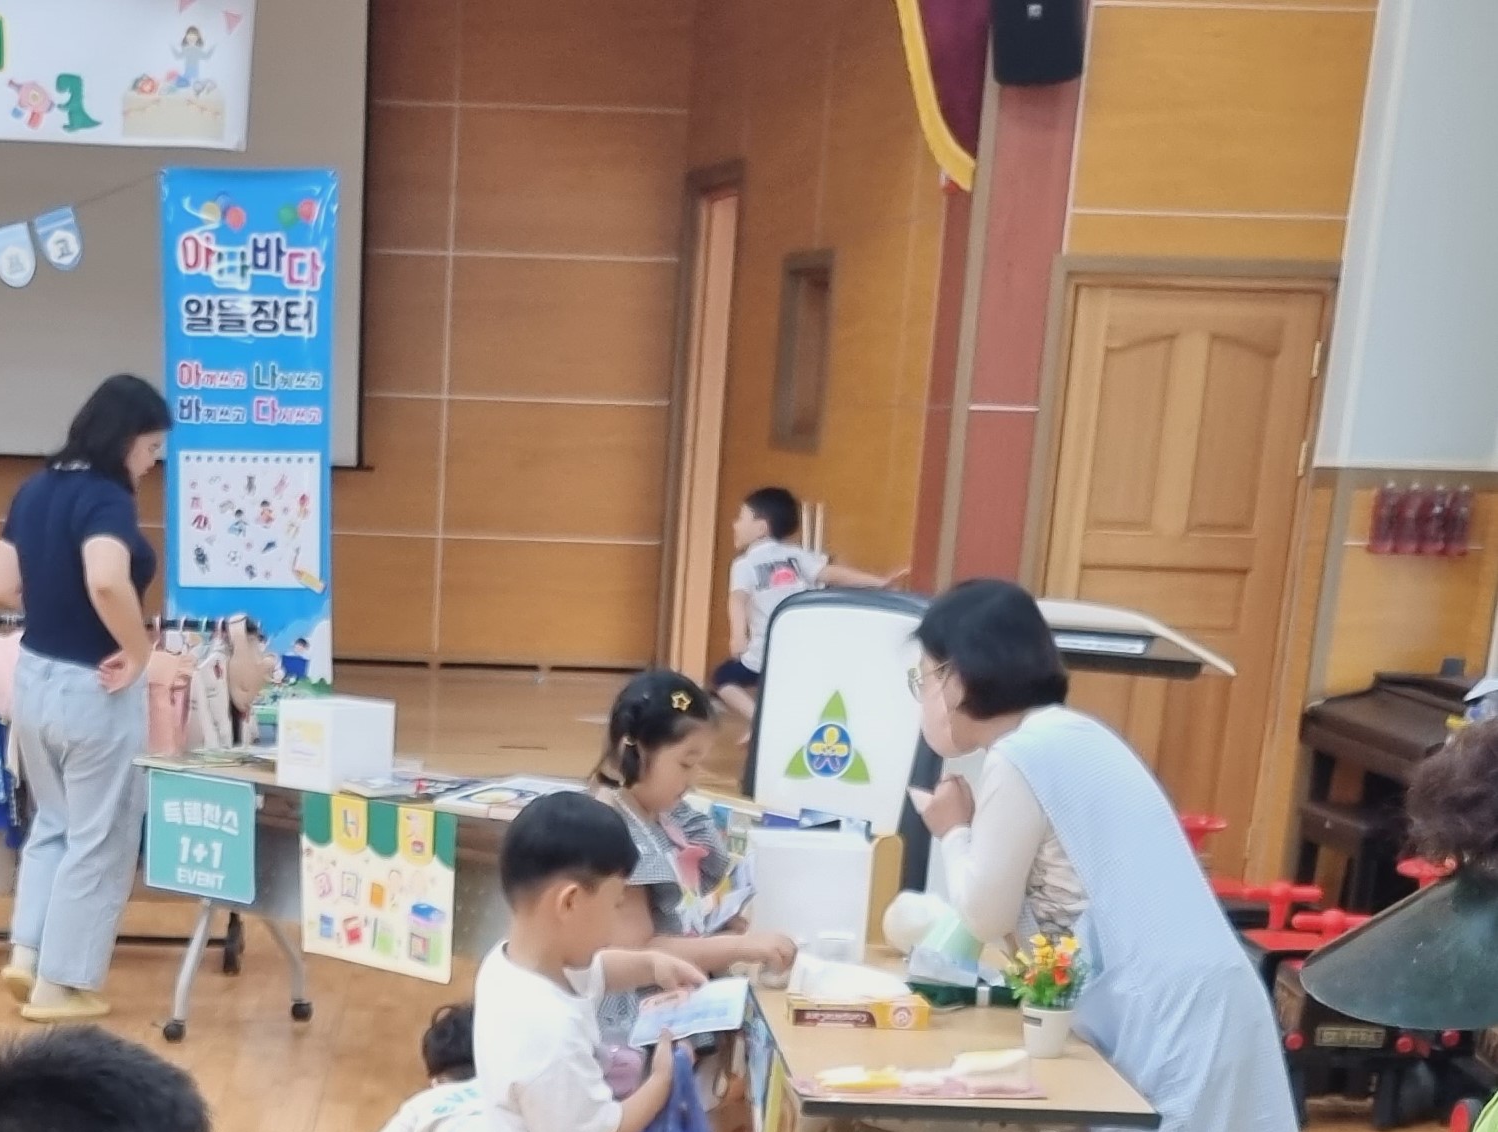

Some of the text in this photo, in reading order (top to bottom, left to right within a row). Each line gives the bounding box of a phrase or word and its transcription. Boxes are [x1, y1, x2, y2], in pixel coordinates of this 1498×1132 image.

[181, 234, 324, 288] 아나바다
[180, 836, 223, 869] 1+1
[176, 867, 225, 890] EVENT
